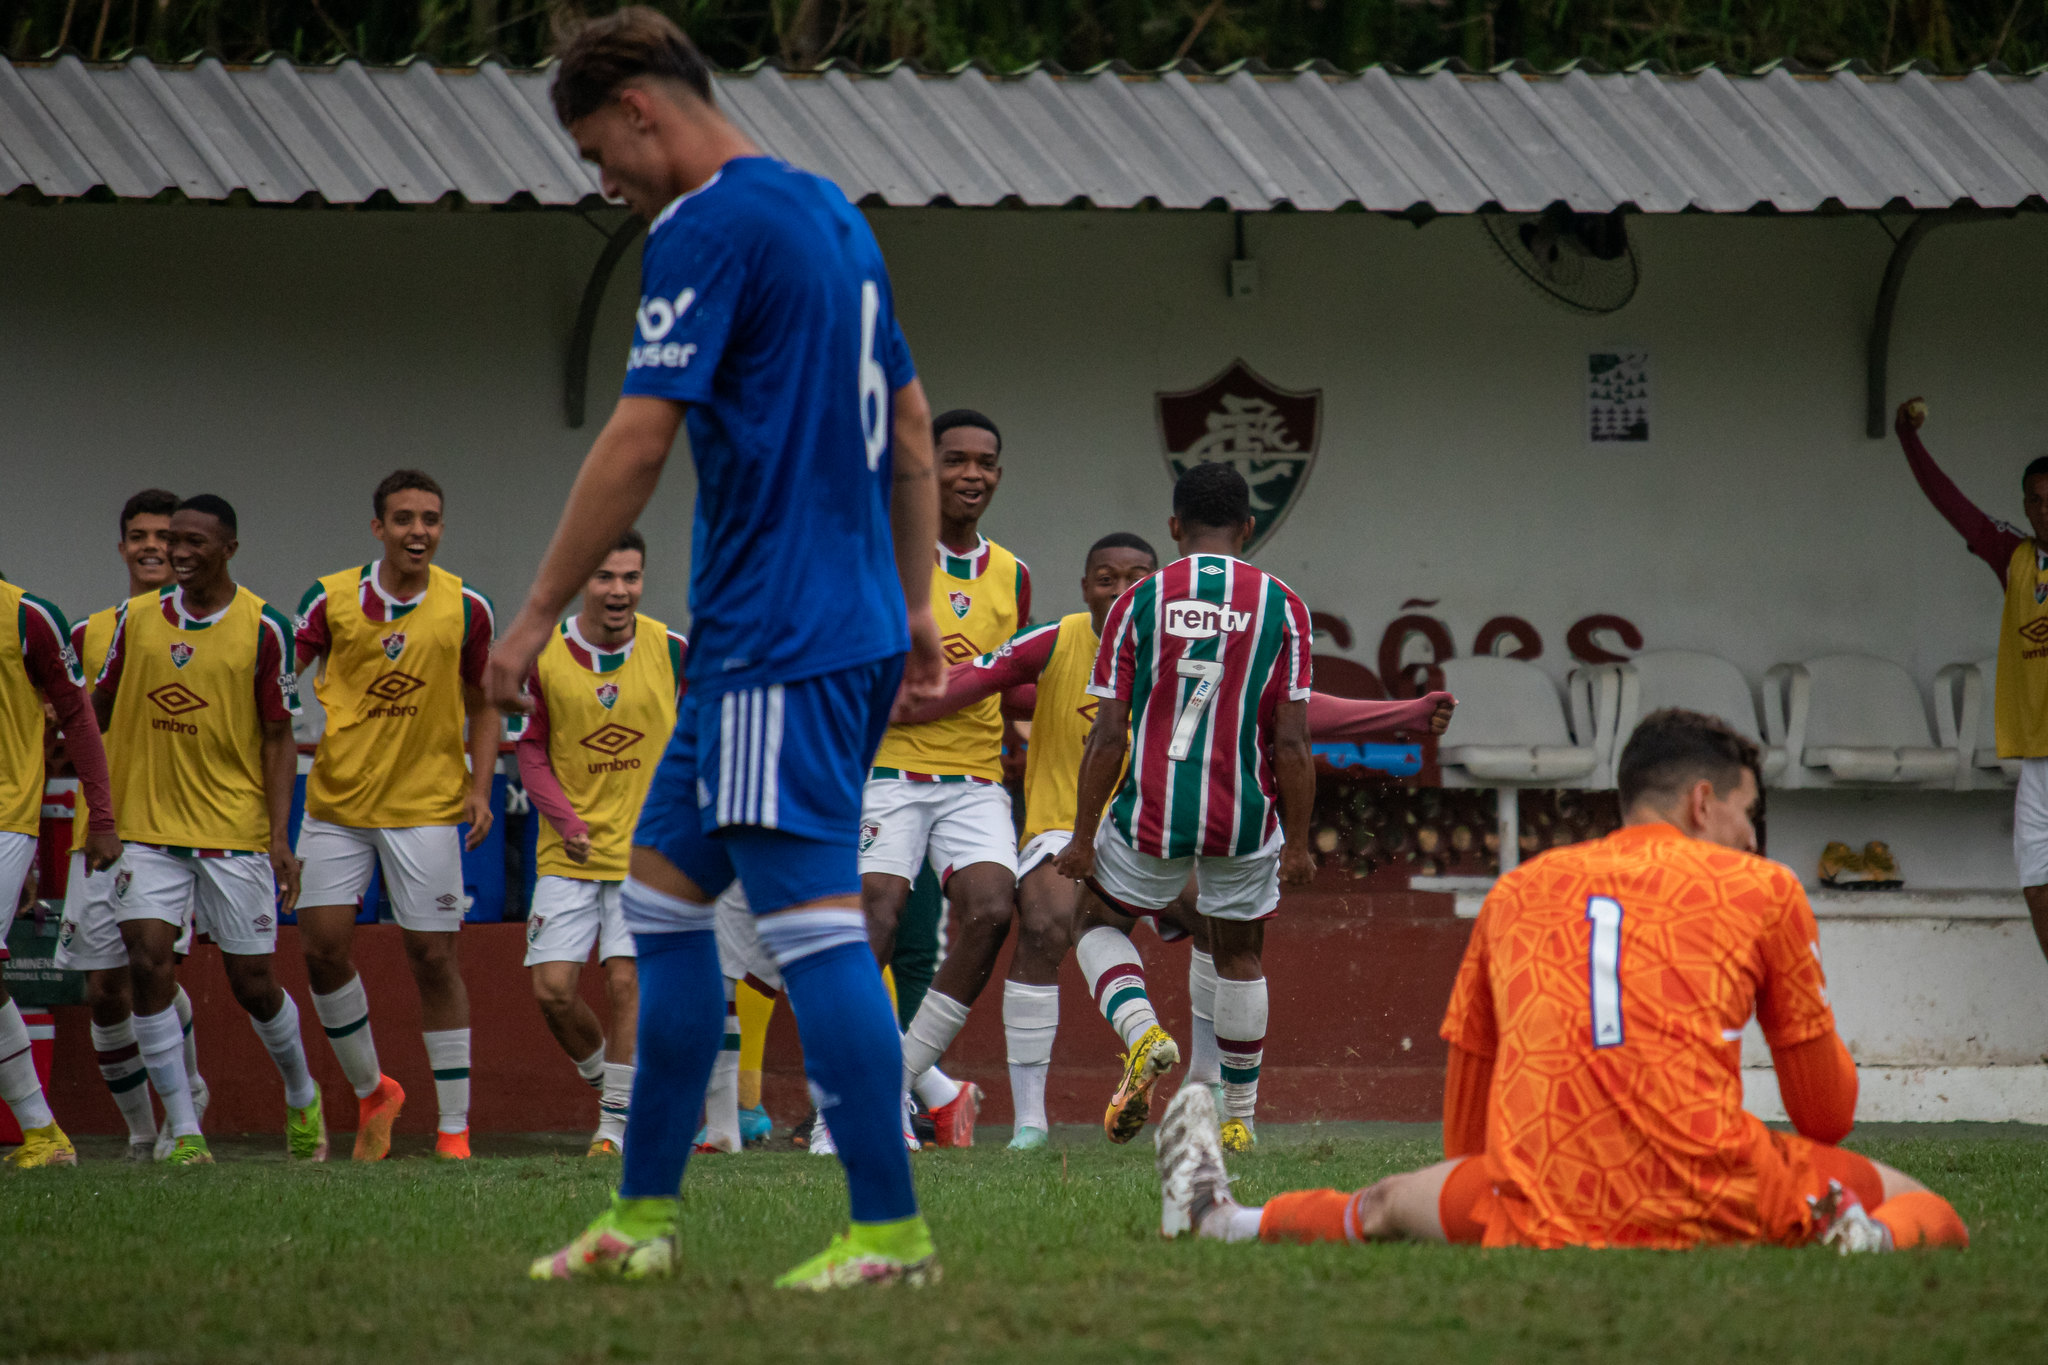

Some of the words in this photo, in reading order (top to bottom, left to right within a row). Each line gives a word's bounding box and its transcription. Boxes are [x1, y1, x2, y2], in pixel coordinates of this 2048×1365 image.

[627, 342, 697, 370] user
[858, 280, 888, 472] 6
[1169, 604, 1252, 632] rentv
[1196, 680, 1211, 698] TIM
[368, 704, 418, 719] umbro
[1167, 658, 1225, 761] 7
[151, 718, 198, 736] umbro
[588, 758, 641, 775] umbro
[1585, 893, 1625, 1050] 1
